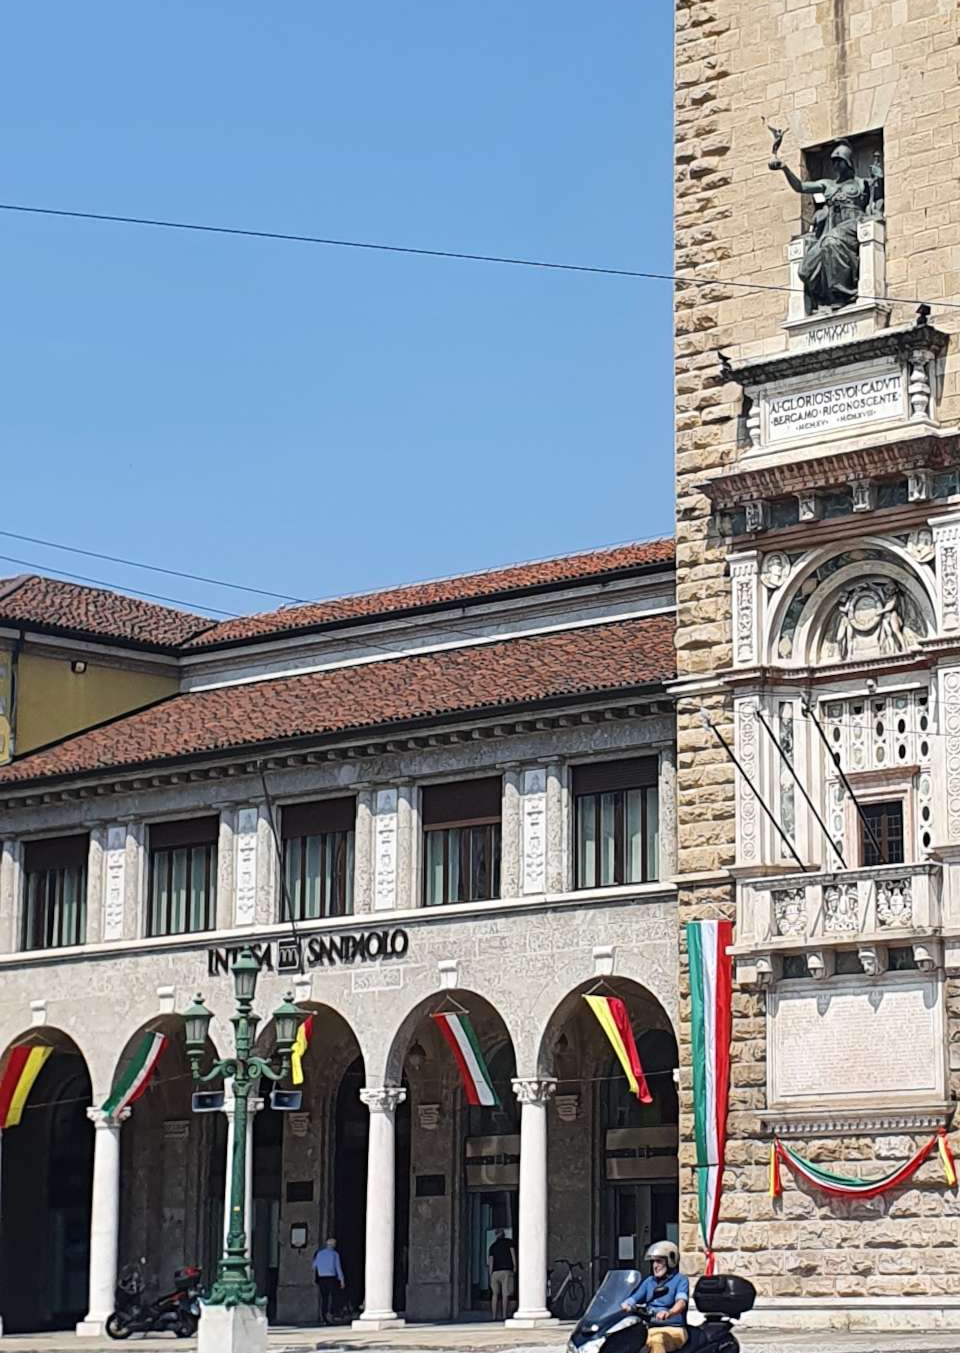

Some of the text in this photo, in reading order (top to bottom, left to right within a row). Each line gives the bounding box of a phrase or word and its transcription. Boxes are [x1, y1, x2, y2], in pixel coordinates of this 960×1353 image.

[823, 391, 899, 416] RICONOSCENTE
[208, 928, 410, 976] INTSA SANPAOLO
